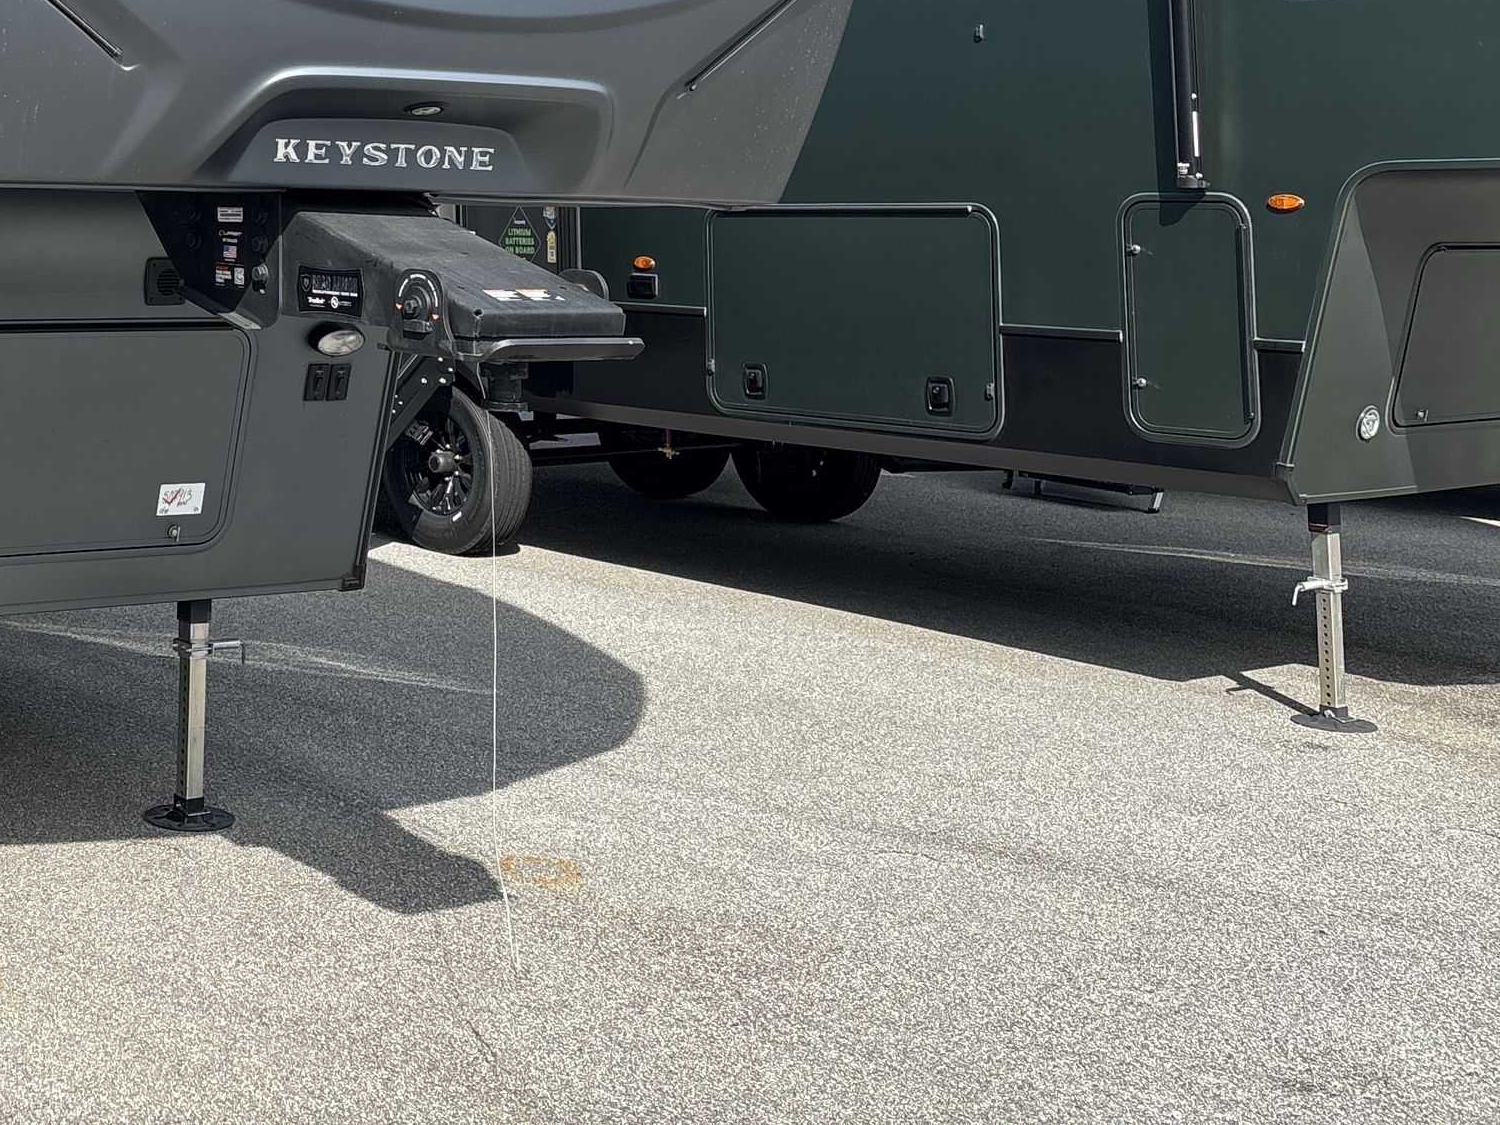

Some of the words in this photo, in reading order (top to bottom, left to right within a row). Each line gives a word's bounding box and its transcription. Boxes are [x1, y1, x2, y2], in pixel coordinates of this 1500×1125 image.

[273, 138, 495, 171] KEYSTONE
[508, 228, 531, 236] LITHIUM
[505, 237, 534, 246] BATTERIES
[515, 246, 535, 255] BOARD
